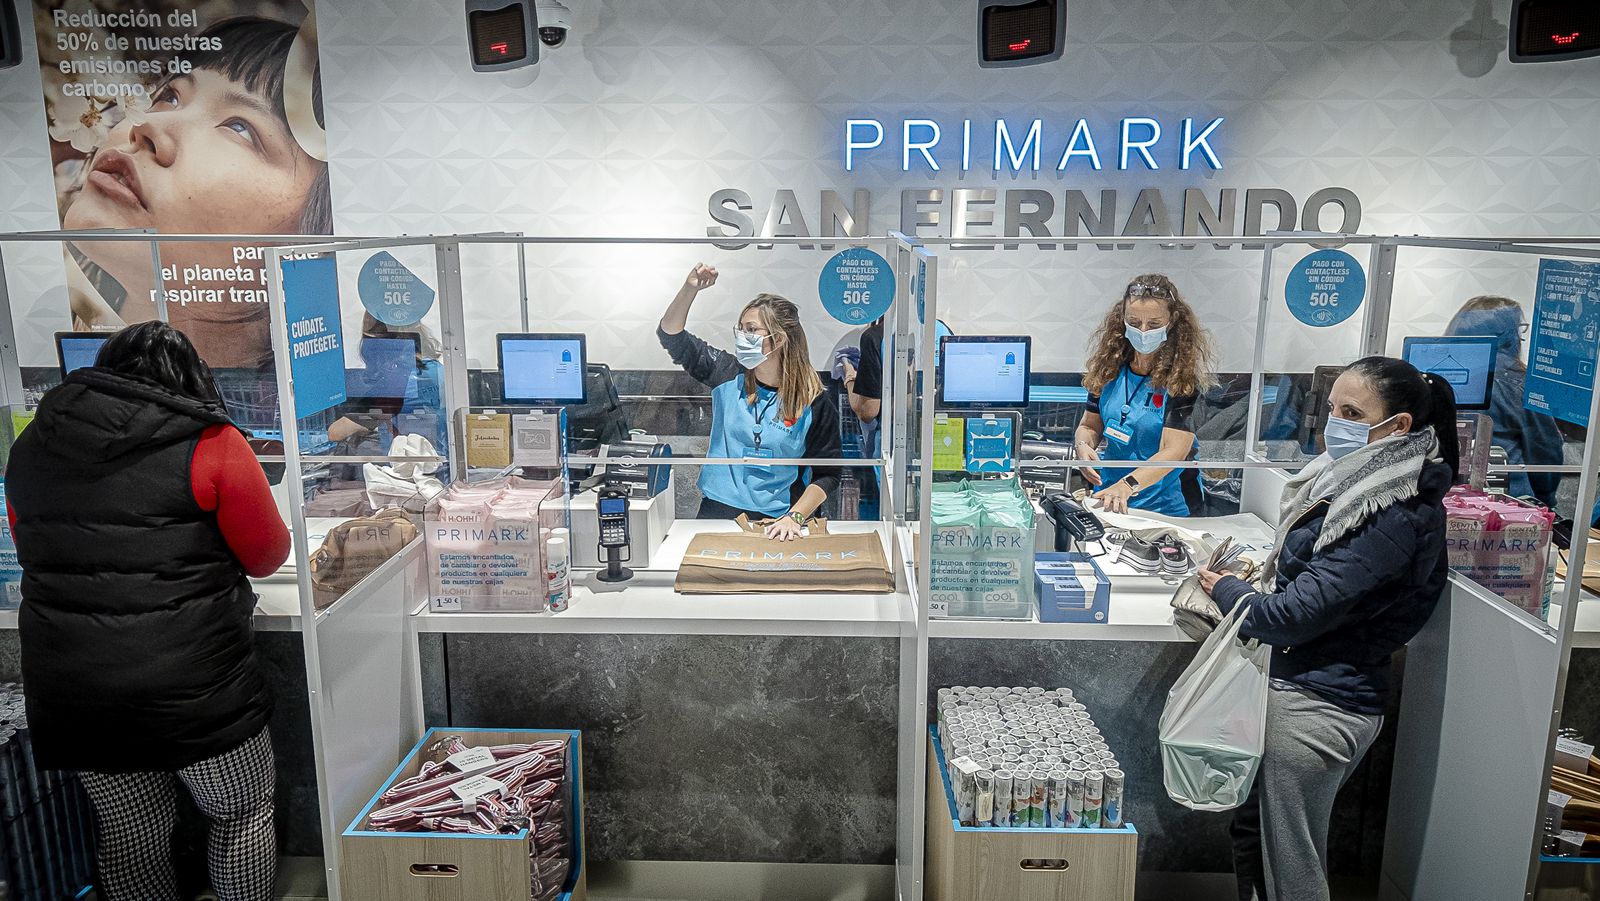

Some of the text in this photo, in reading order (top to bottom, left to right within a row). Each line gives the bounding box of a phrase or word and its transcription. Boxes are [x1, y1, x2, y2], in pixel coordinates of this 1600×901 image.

[53, 9, 198, 27] Reducción del
[56, 32, 223, 51] 50% de nuestras
[59, 56, 192, 74] emisiones de
[846, 118, 1225, 171] PRIMARK
[706, 187, 1362, 250] SAN FERNANDO
[233, 246, 265, 264] par
[1312, 260, 1345, 268] PAGO CON
[162, 264, 178, 281] el
[183, 264, 254, 285] planeta
[1305, 268, 1350, 276] CONTACTLESS
[229, 286, 269, 302] tran
[1315, 283, 1337, 291] HASTA
[384, 292, 412, 305] 50€
[843, 290, 871, 305] 50€
[1309, 292, 1340, 307] 50€
[291, 316, 327, 339] CUÍDATE.
[293, 334, 340, 360] PROTÉGETE.
[437, 528, 526, 541] PRIMARK
[931, 534, 1021, 548] PRIMARK
[1446, 538, 1537, 552] PRIMARK
[700, 549, 858, 561] PRIMARK
[932, 559, 964, 567] Estamos
[965, 559, 1008, 567] encantados
[441, 570, 477, 578] productos
[490, 569, 527, 578] cualquiera
[981, 568, 1012, 577] devolver
[485, 578, 504, 586] cajas
[931, 576, 967, 584] productos
[981, 577, 1019, 586] cualquiera
